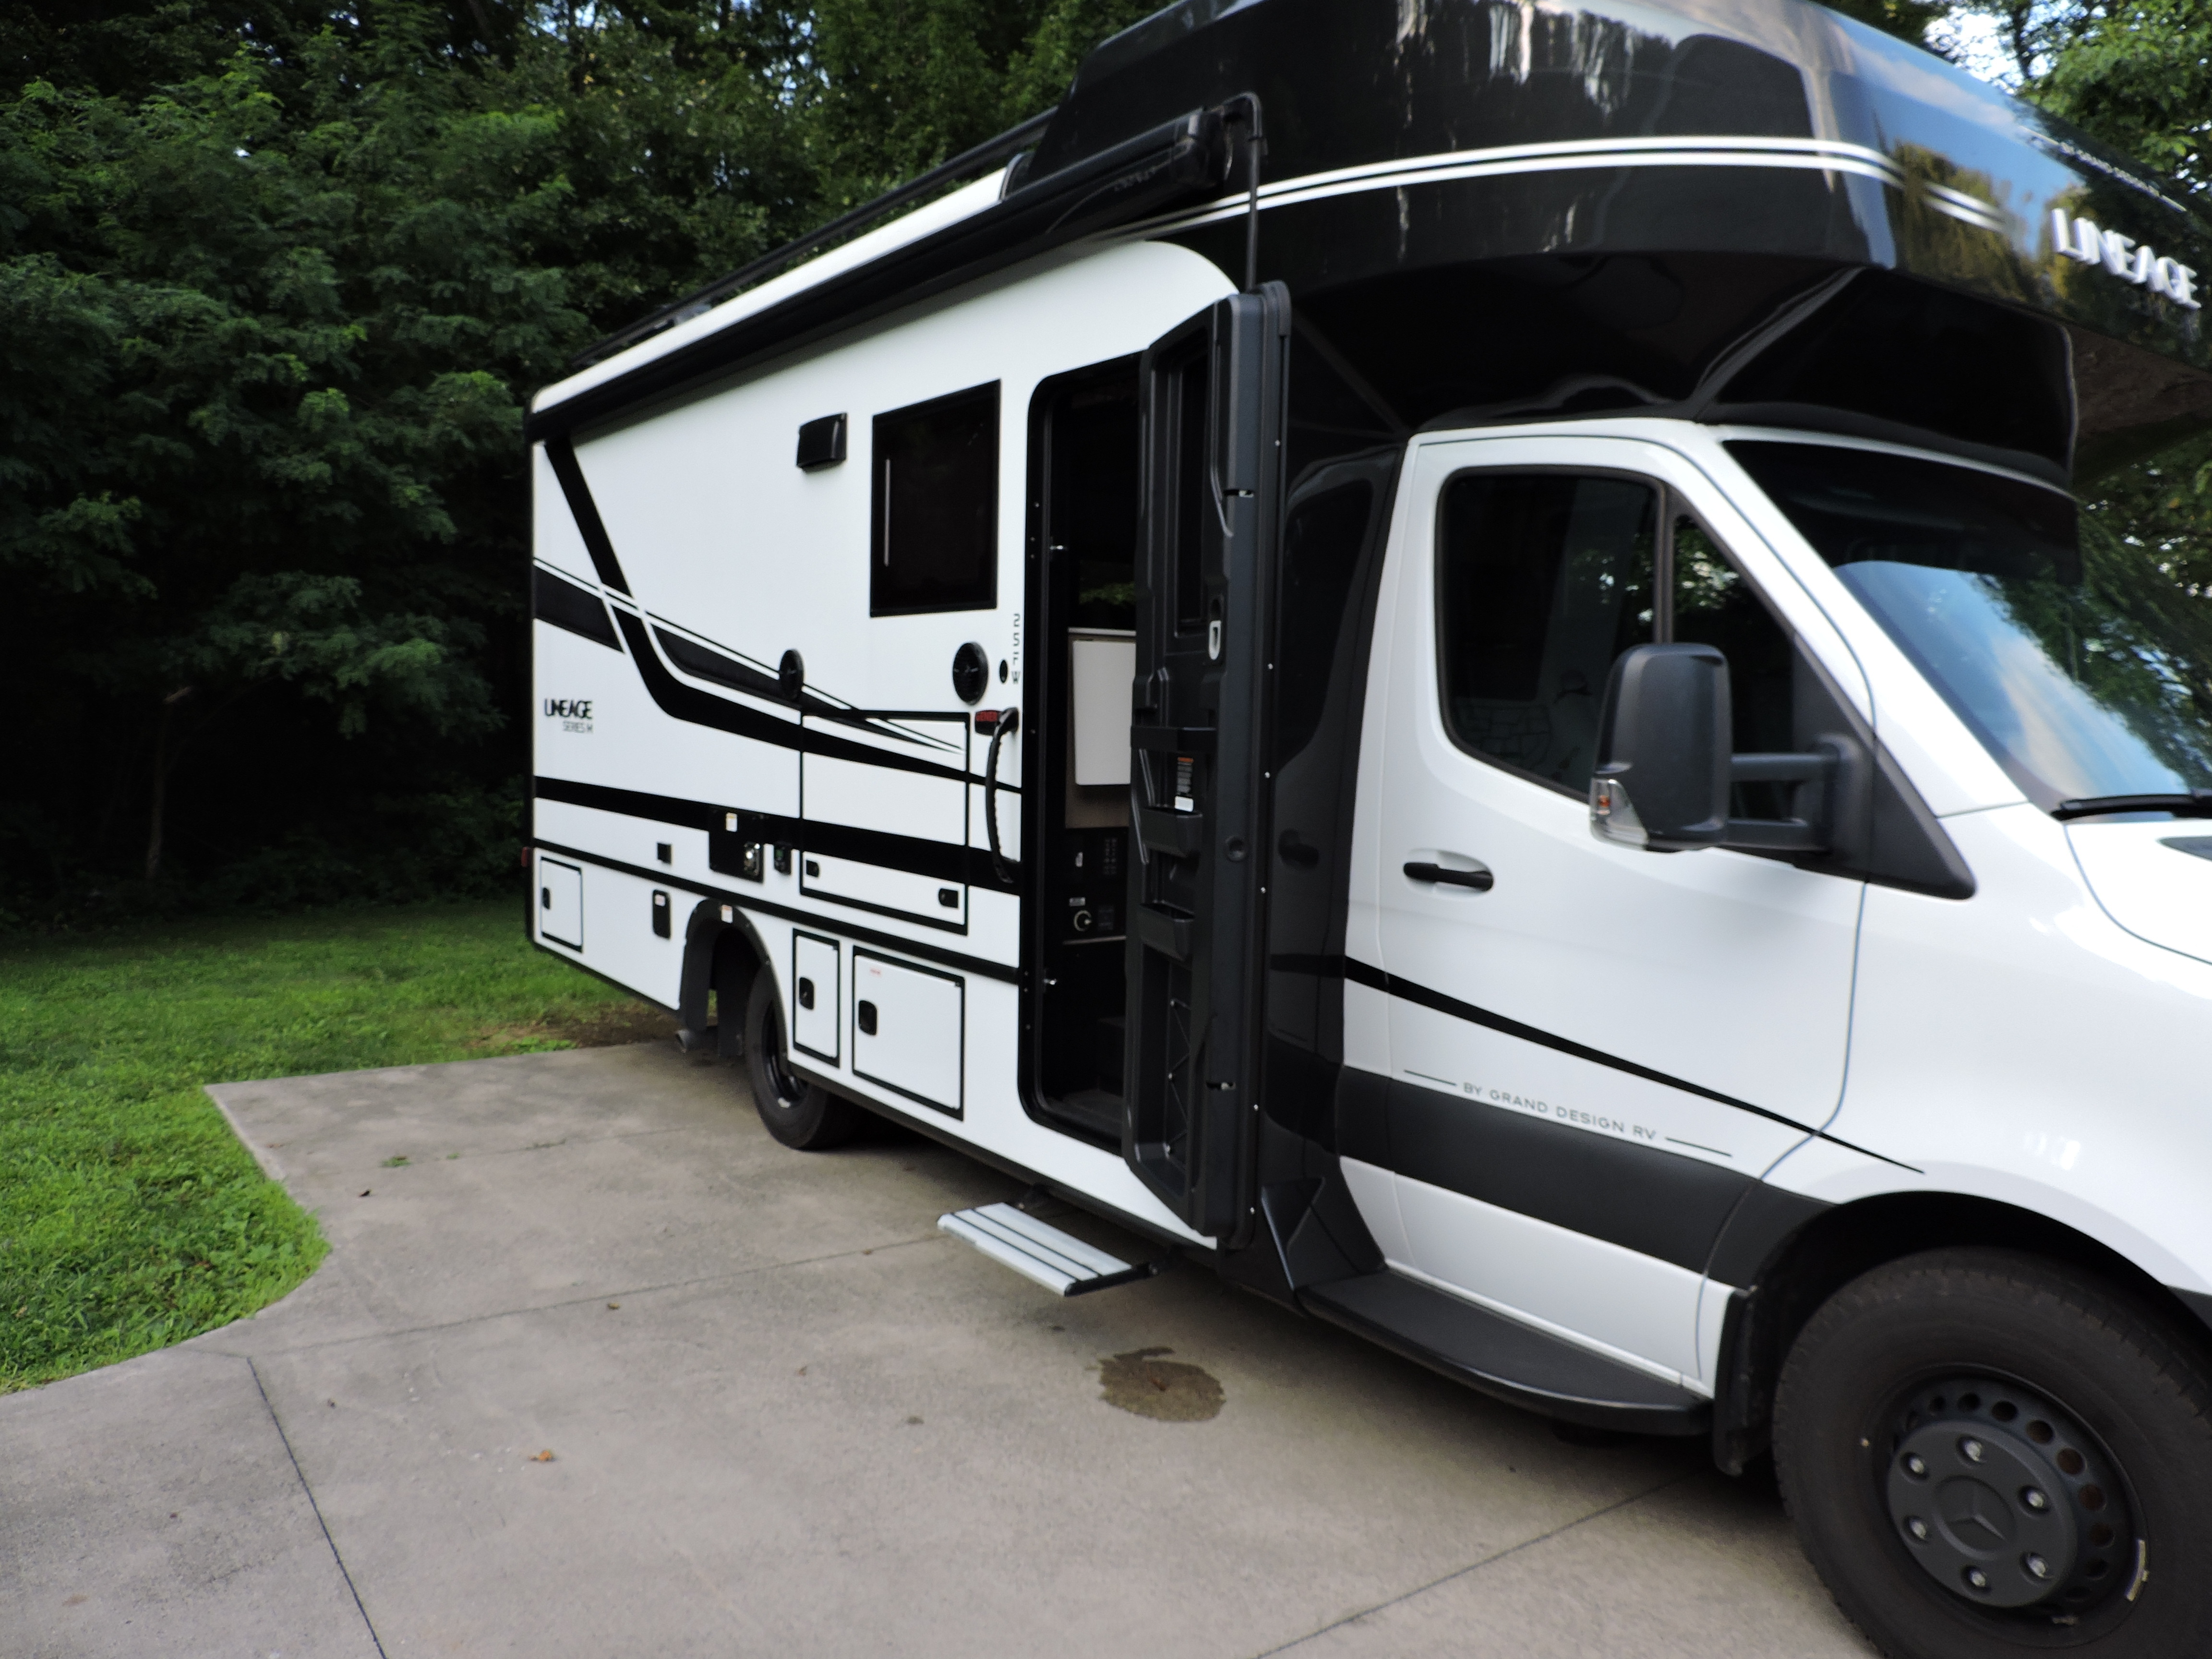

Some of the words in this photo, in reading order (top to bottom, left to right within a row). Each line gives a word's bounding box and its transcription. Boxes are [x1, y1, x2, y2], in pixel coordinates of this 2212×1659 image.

[2052, 208, 2201, 309] LINEAGE
[544, 699, 592, 720] LINEAGE
[1463, 1082, 1482, 1096] BY
[1489, 1089, 1549, 1113] GRAND
[1556, 1106, 1624, 1133] DESIGN
[1632, 1124, 1657, 1140] RV
